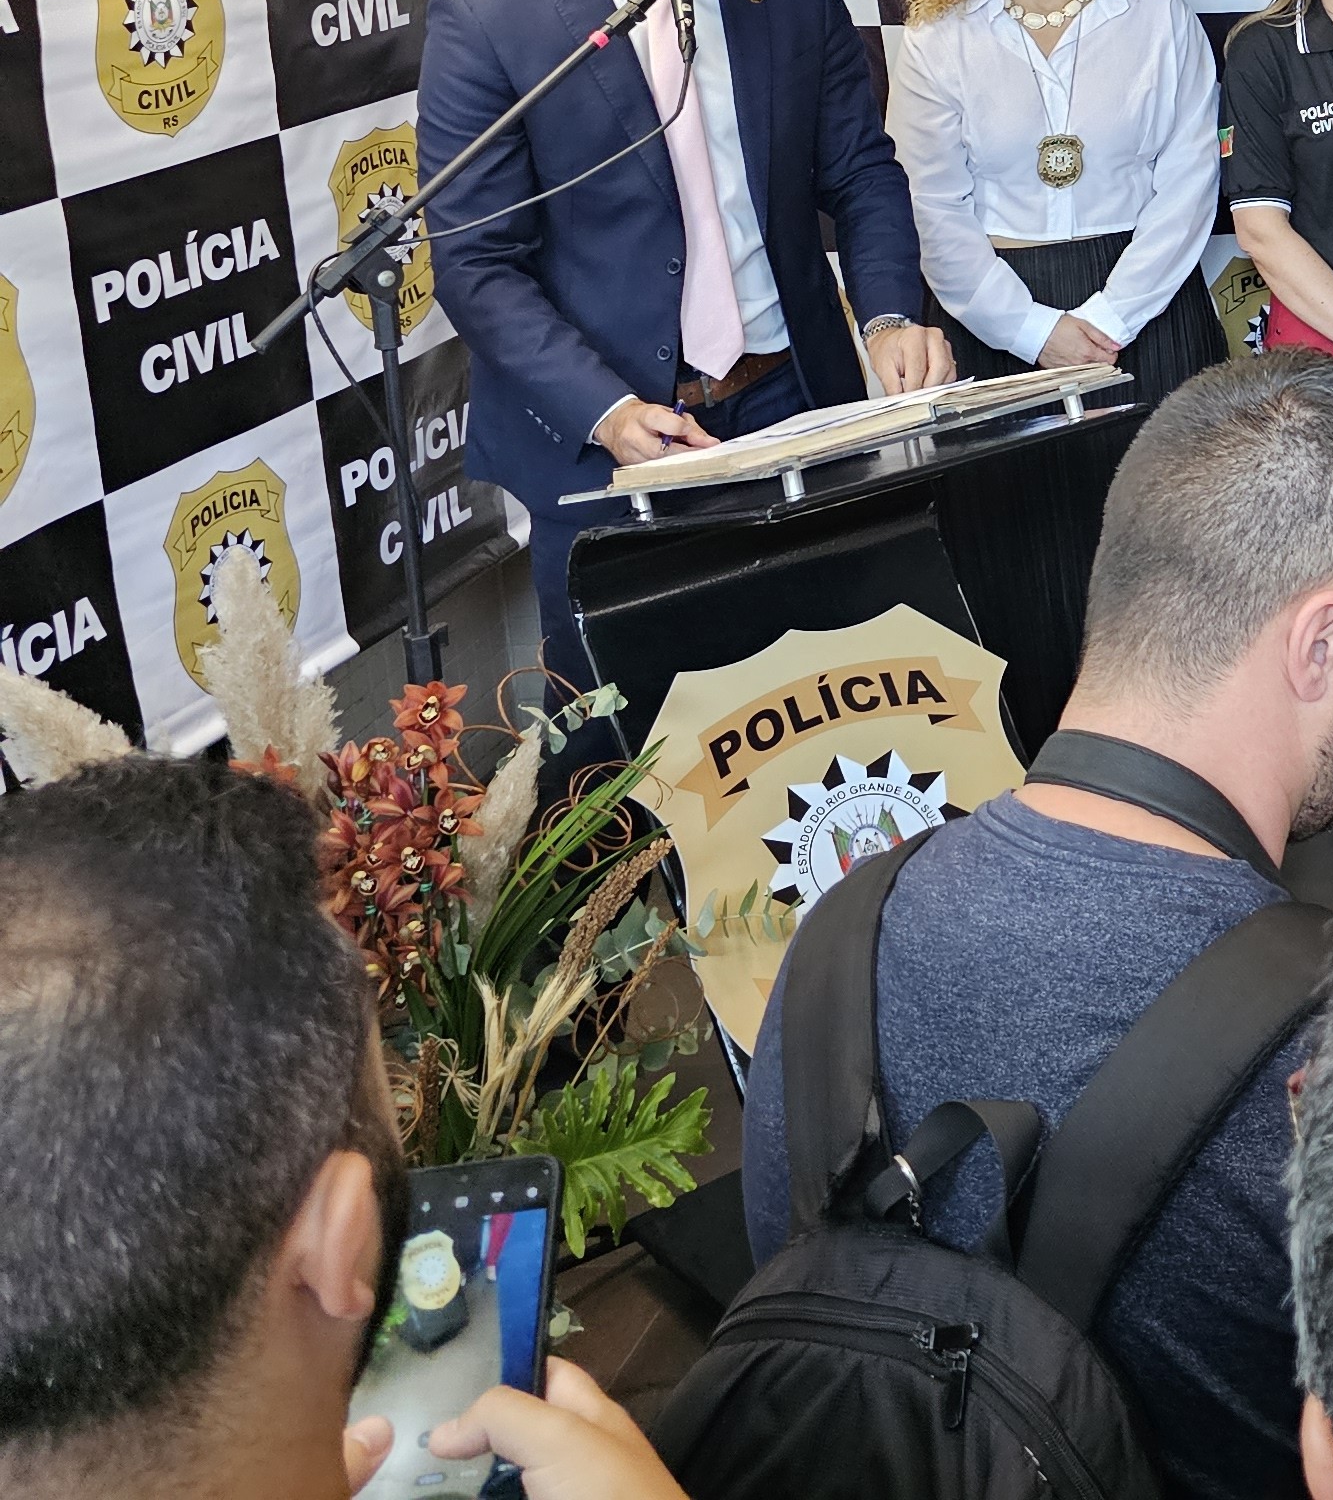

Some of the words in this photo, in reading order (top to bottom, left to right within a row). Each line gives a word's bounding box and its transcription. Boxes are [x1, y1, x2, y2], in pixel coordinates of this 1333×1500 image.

[133, 79, 196, 110] CIVIL
[162, 114, 179, 130] RS
[350, 147, 410, 184] POLÍCIA
[91, 218, 281, 324] POLÍCIA
[399, 283, 427, 309] VIL
[140, 312, 257, 393] CIVIL
[340, 402, 470, 508] POÍCI
[190, 488, 262, 539] POLÍCIA
[379, 485, 473, 565] CVIL
[0, 596, 108, 677] ÍCIA
[708, 672, 948, 779] POLÍCIA
[798, 824, 813, 875] ESTADO
[811, 807, 826, 824] DO
[826, 791, 846, 808] RIO
[849, 782, 902, 795] GRANDE
[904, 791, 921, 805] DO
[920, 803, 938, 826] SUL
